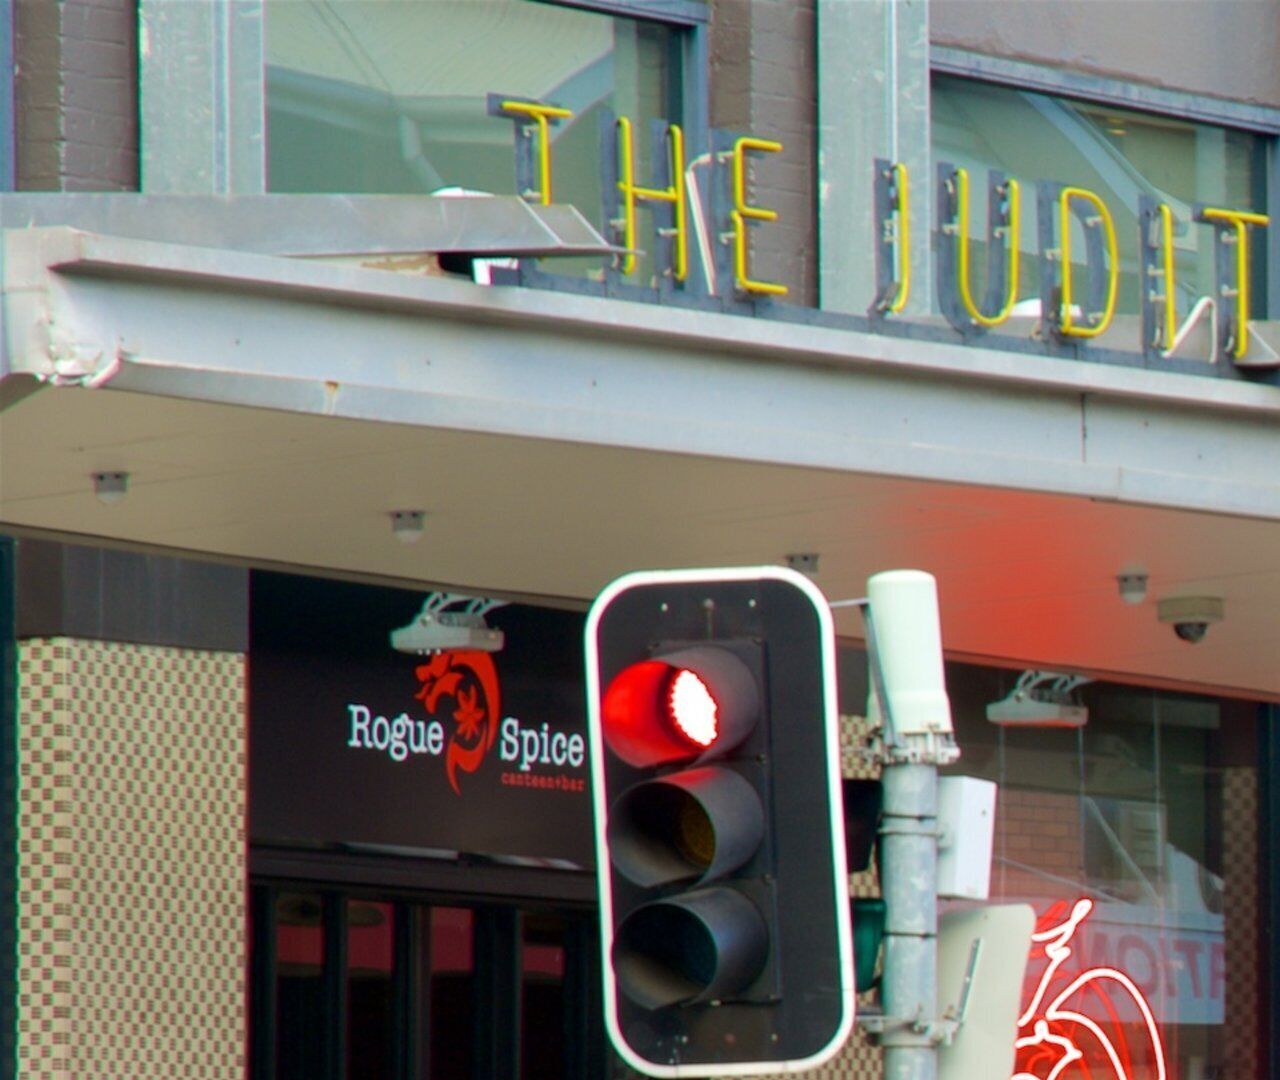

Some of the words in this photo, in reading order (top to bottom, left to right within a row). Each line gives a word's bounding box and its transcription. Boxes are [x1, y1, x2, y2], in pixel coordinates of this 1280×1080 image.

[488, 94, 788, 300] THE
[347, 704, 445, 762] Rogue
[500, 717, 585, 771] Spice
